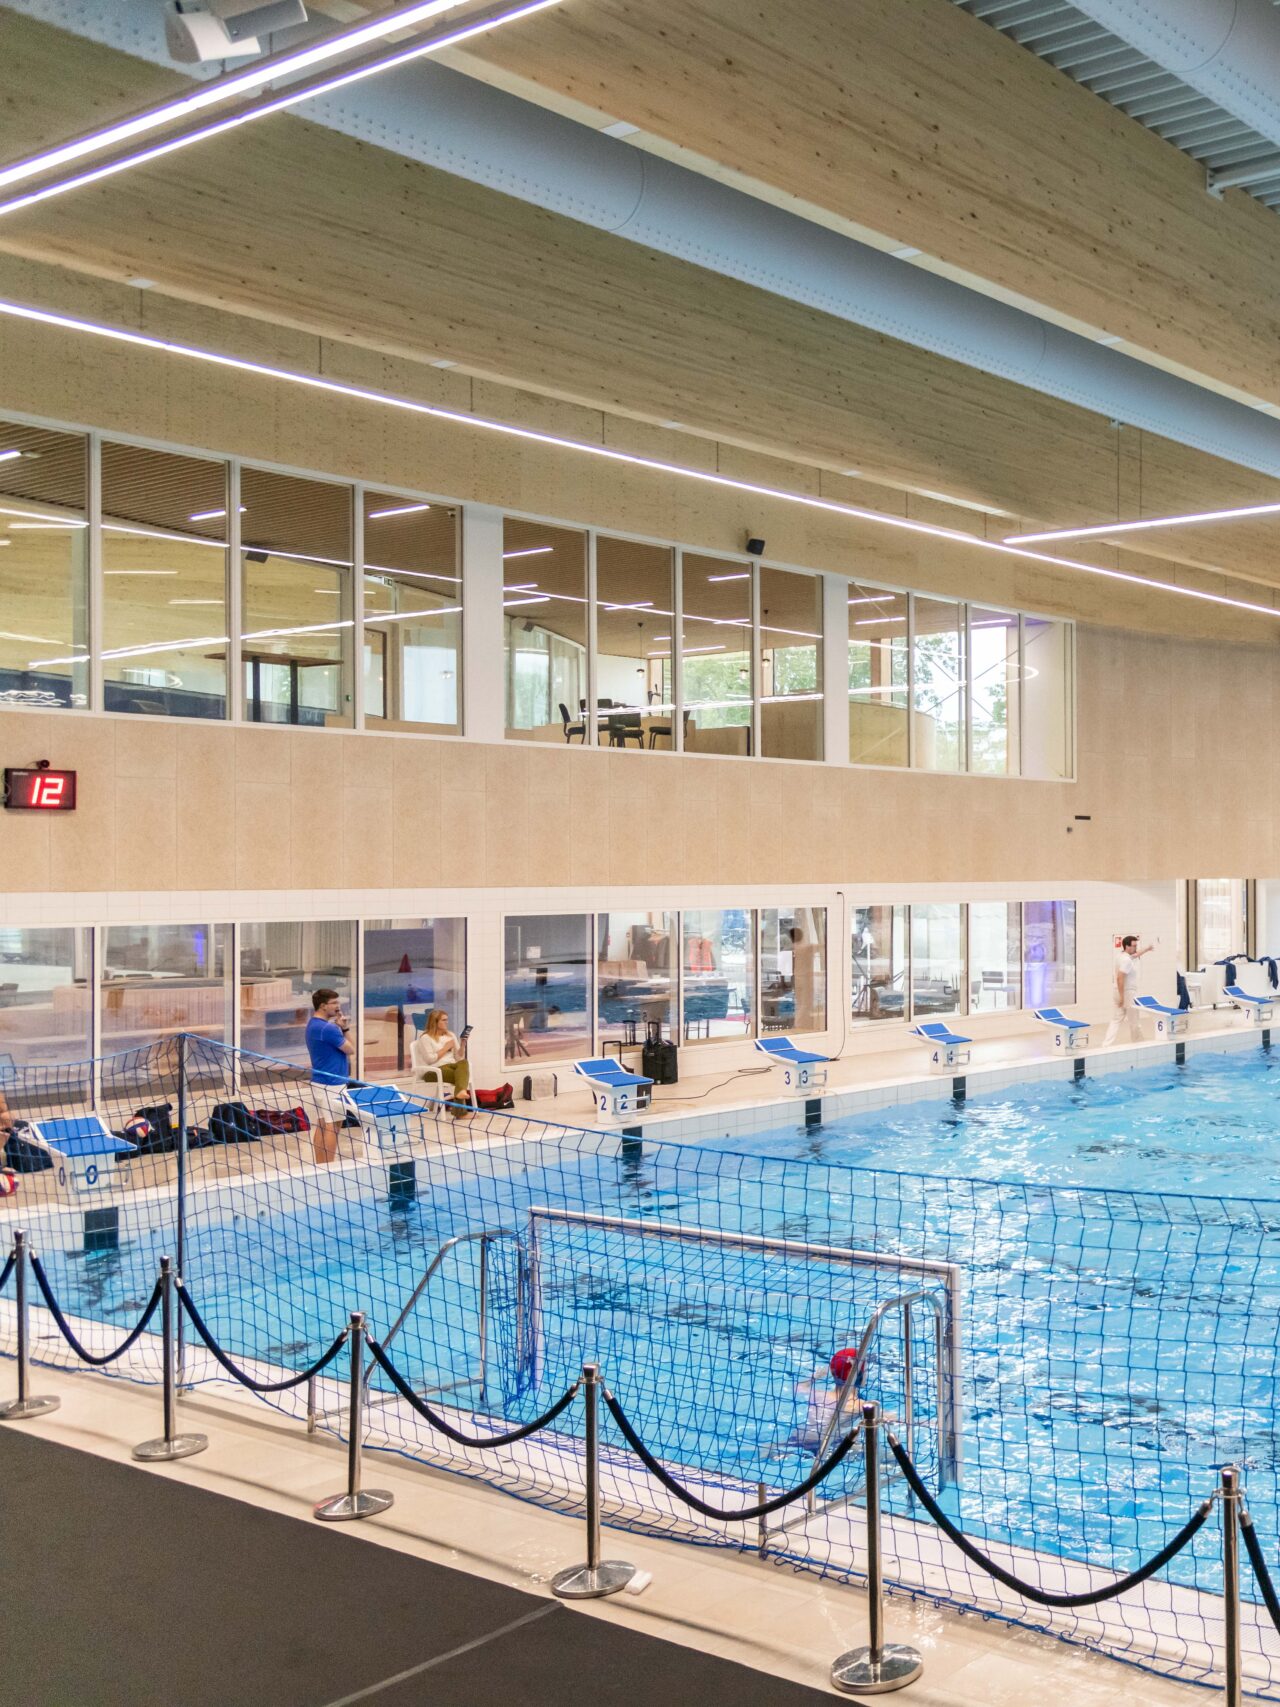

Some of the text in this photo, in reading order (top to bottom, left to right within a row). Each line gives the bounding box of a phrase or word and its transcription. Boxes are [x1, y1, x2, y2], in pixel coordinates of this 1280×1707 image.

[31, 777, 64, 805] 12
[1245, 1009, 1251, 1019] 7
[1157, 1020, 1163, 1032] 6
[1056, 1035, 1061, 1046] 5
[933, 1051, 939, 1063] 4
[784, 1071, 791, 1085] 3
[802, 1070, 808, 1084] 3
[600, 1095, 607, 1111] 2
[620, 1094, 628, 1110] 2
[365, 1127, 371, 1144] 1
[390, 1125, 396, 1142] 1
